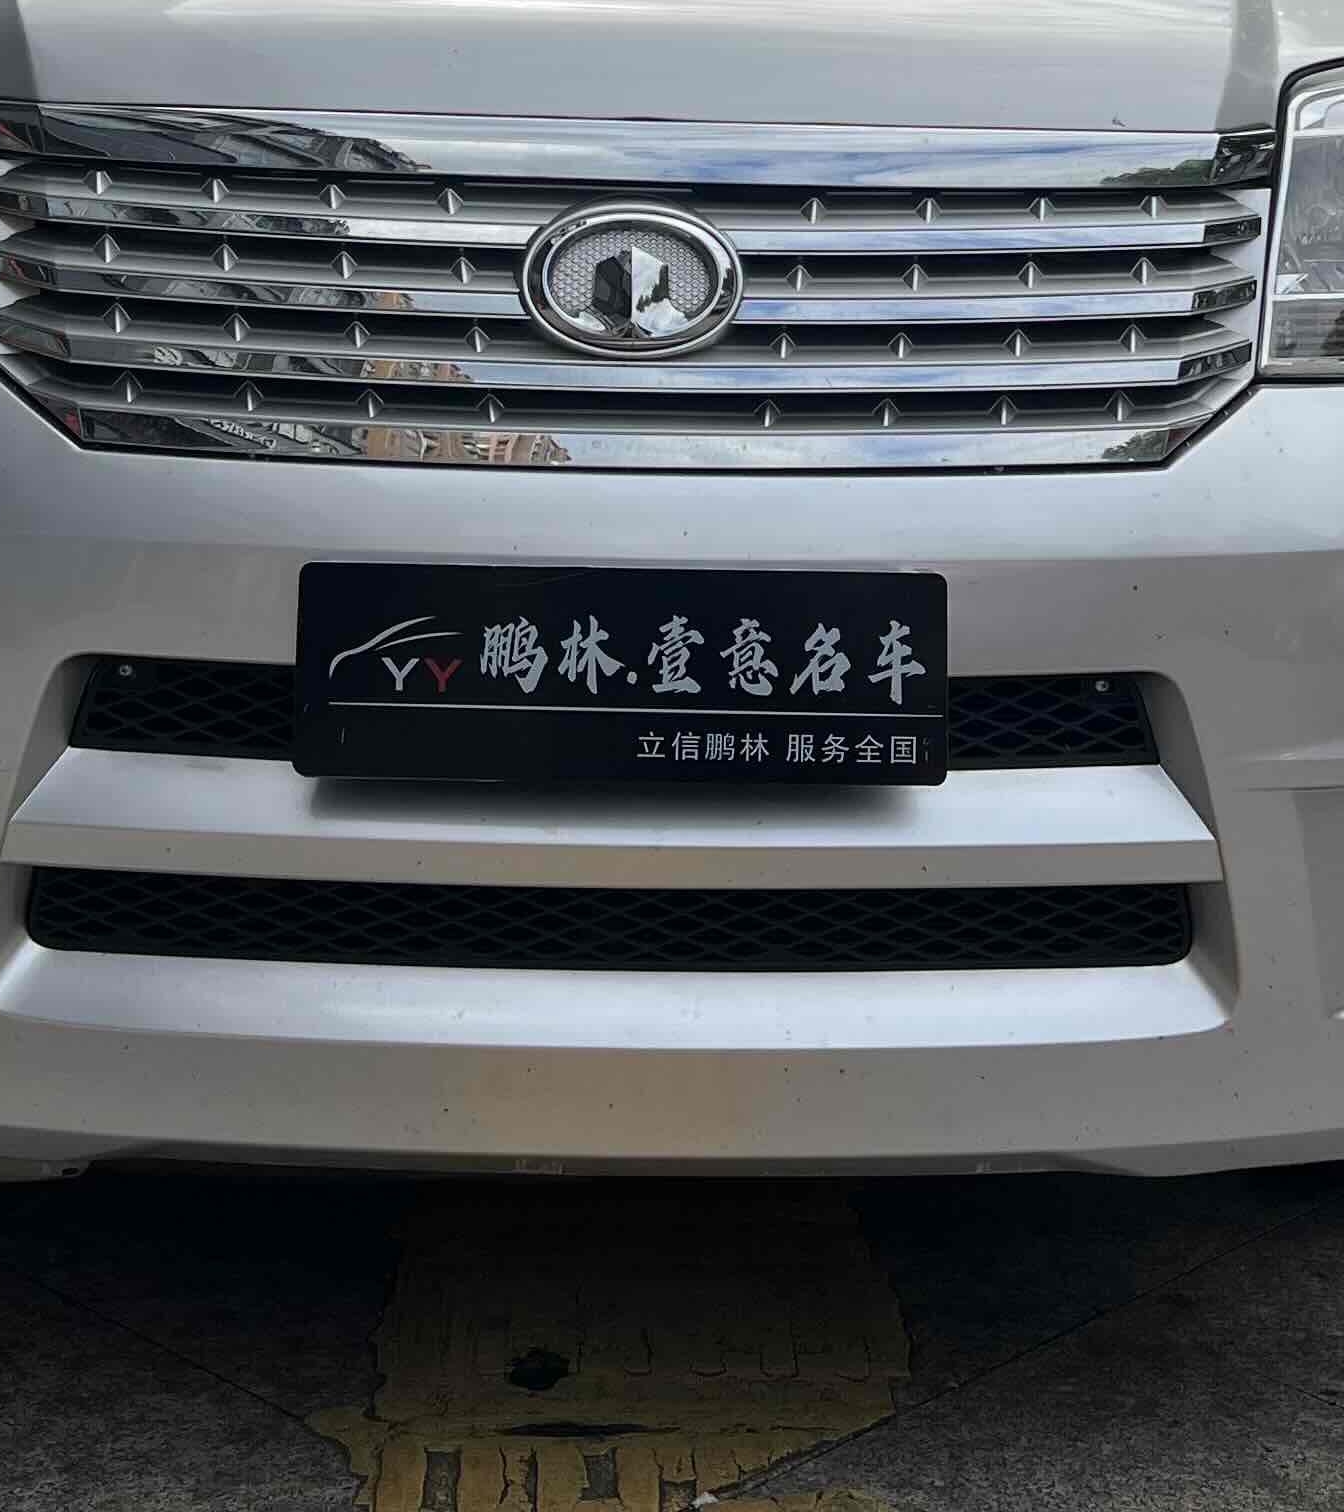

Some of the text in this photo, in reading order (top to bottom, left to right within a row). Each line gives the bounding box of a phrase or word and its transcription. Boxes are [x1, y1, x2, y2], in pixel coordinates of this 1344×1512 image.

[636, 730, 918, 765] 立信鹏林 服务全国
